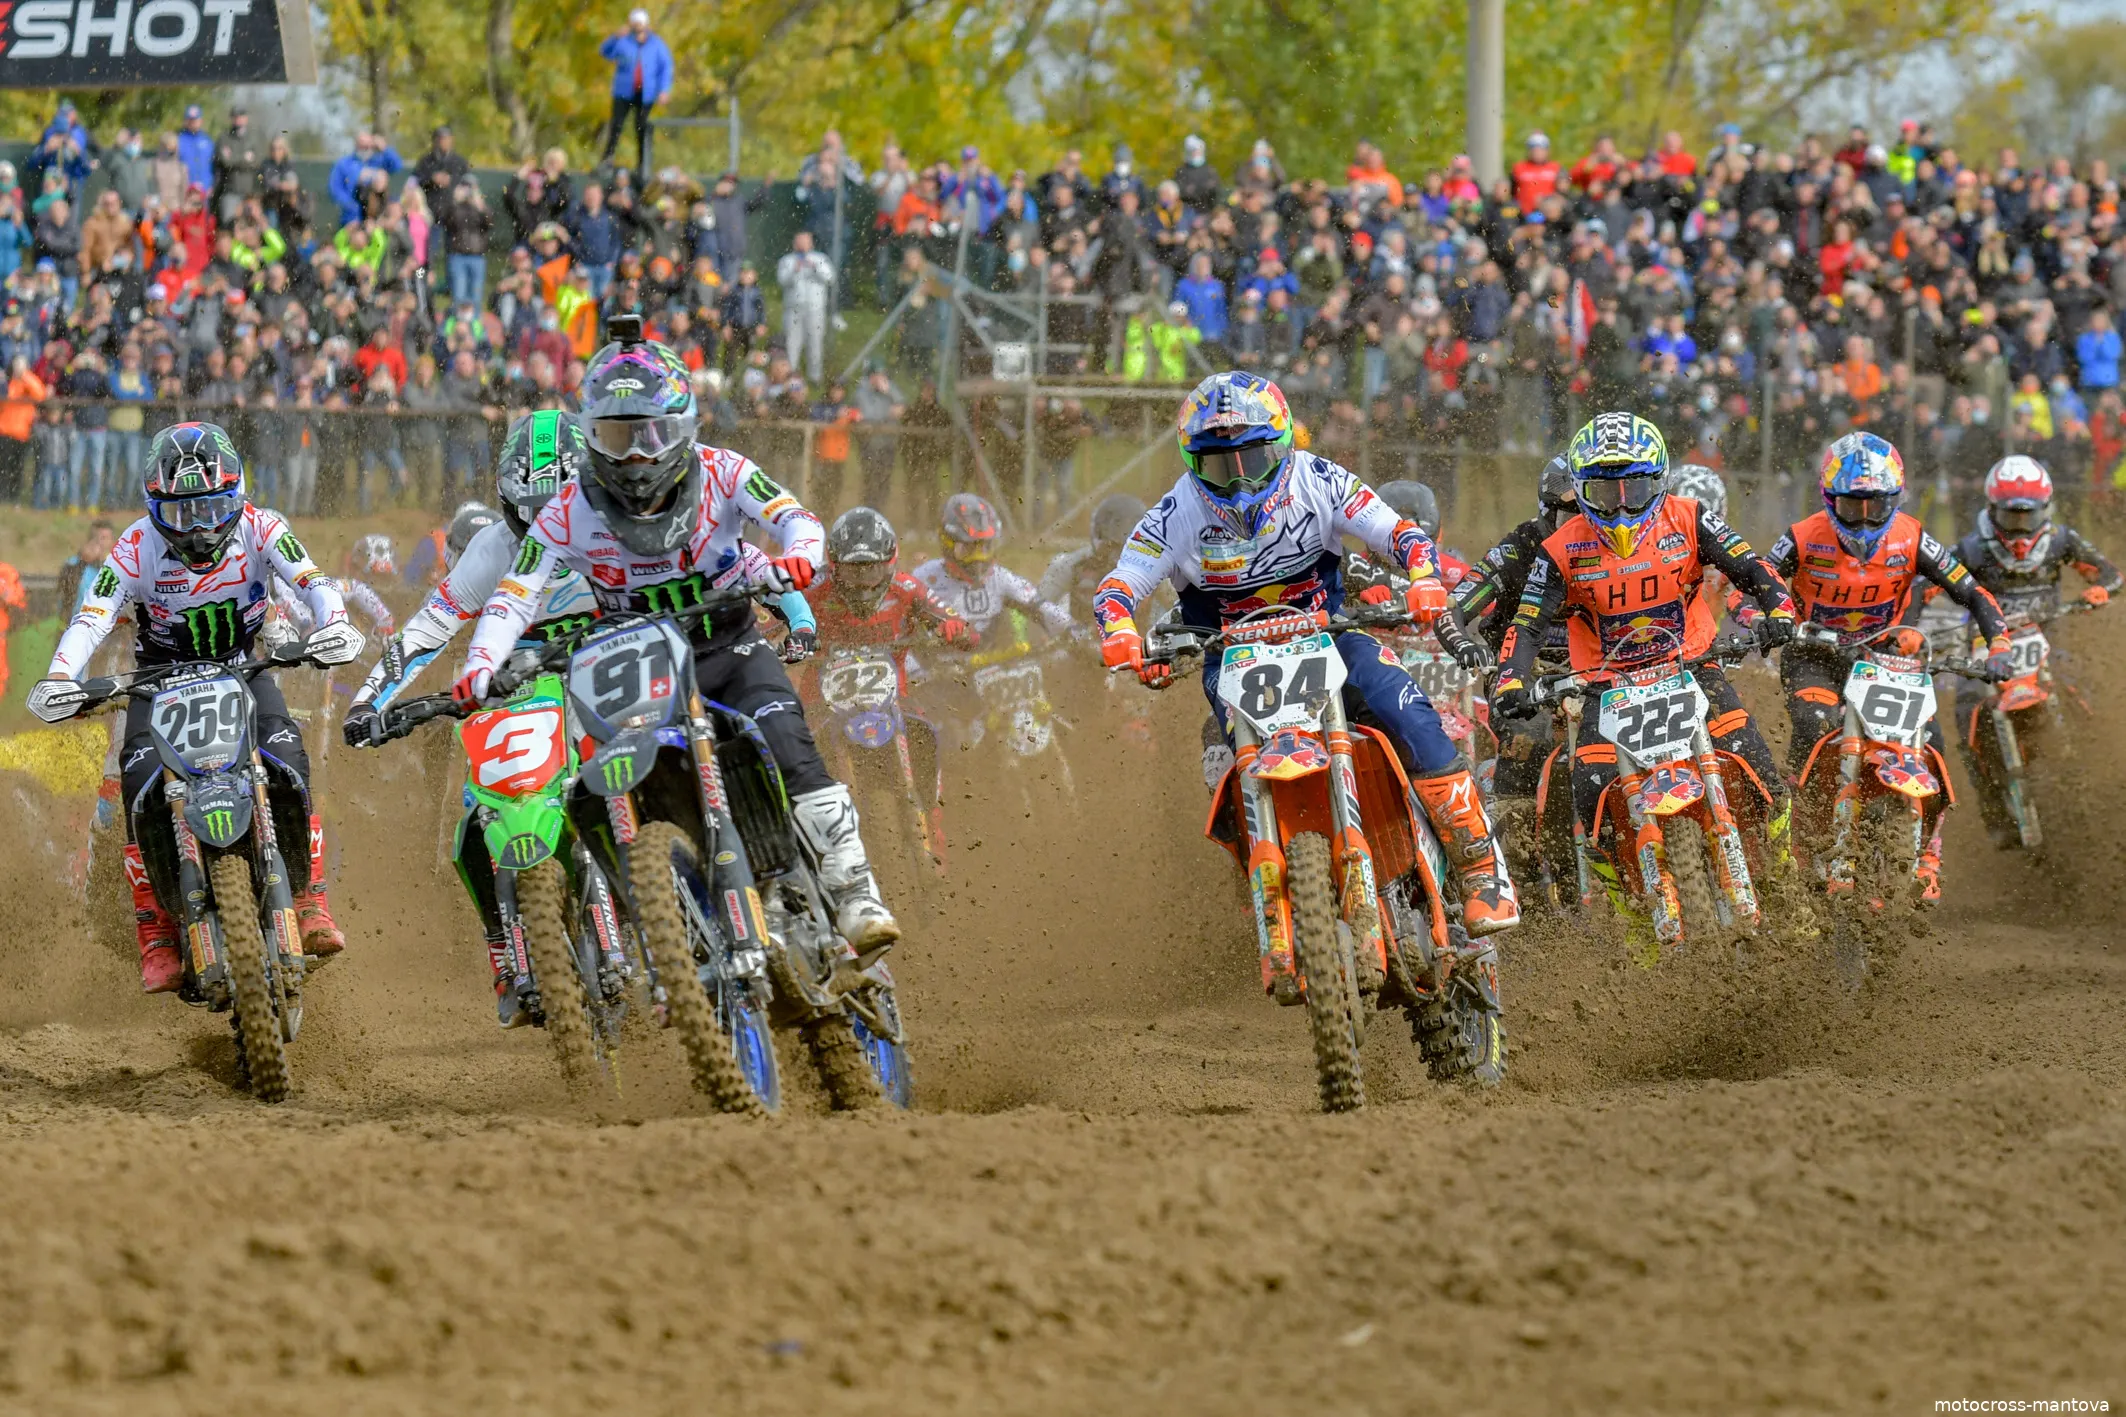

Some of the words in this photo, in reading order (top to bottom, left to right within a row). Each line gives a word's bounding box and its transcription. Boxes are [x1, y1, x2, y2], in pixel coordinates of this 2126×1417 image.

[1566, 541, 1598, 550] PARTS
[632, 563, 673, 576] WILVO
[1577, 571, 1608, 581] MOTOREX
[599, 632, 641, 653] YAMAHA
[180, 683, 215, 698] YAMAHA
[593, 640, 671, 720] 91
[831, 664, 888, 701] 32
[1239, 657, 1331, 721] 84
[160, 691, 244, 754] 259
[1617, 691, 1697, 753] 222
[1861, 684, 1926, 731] 61
[479, 711, 560, 787] 3
[200, 800, 234, 811] YAMAHA
[593, 904, 611, 950] BRAKING
[594, 876, 622, 951] DUNLOP
